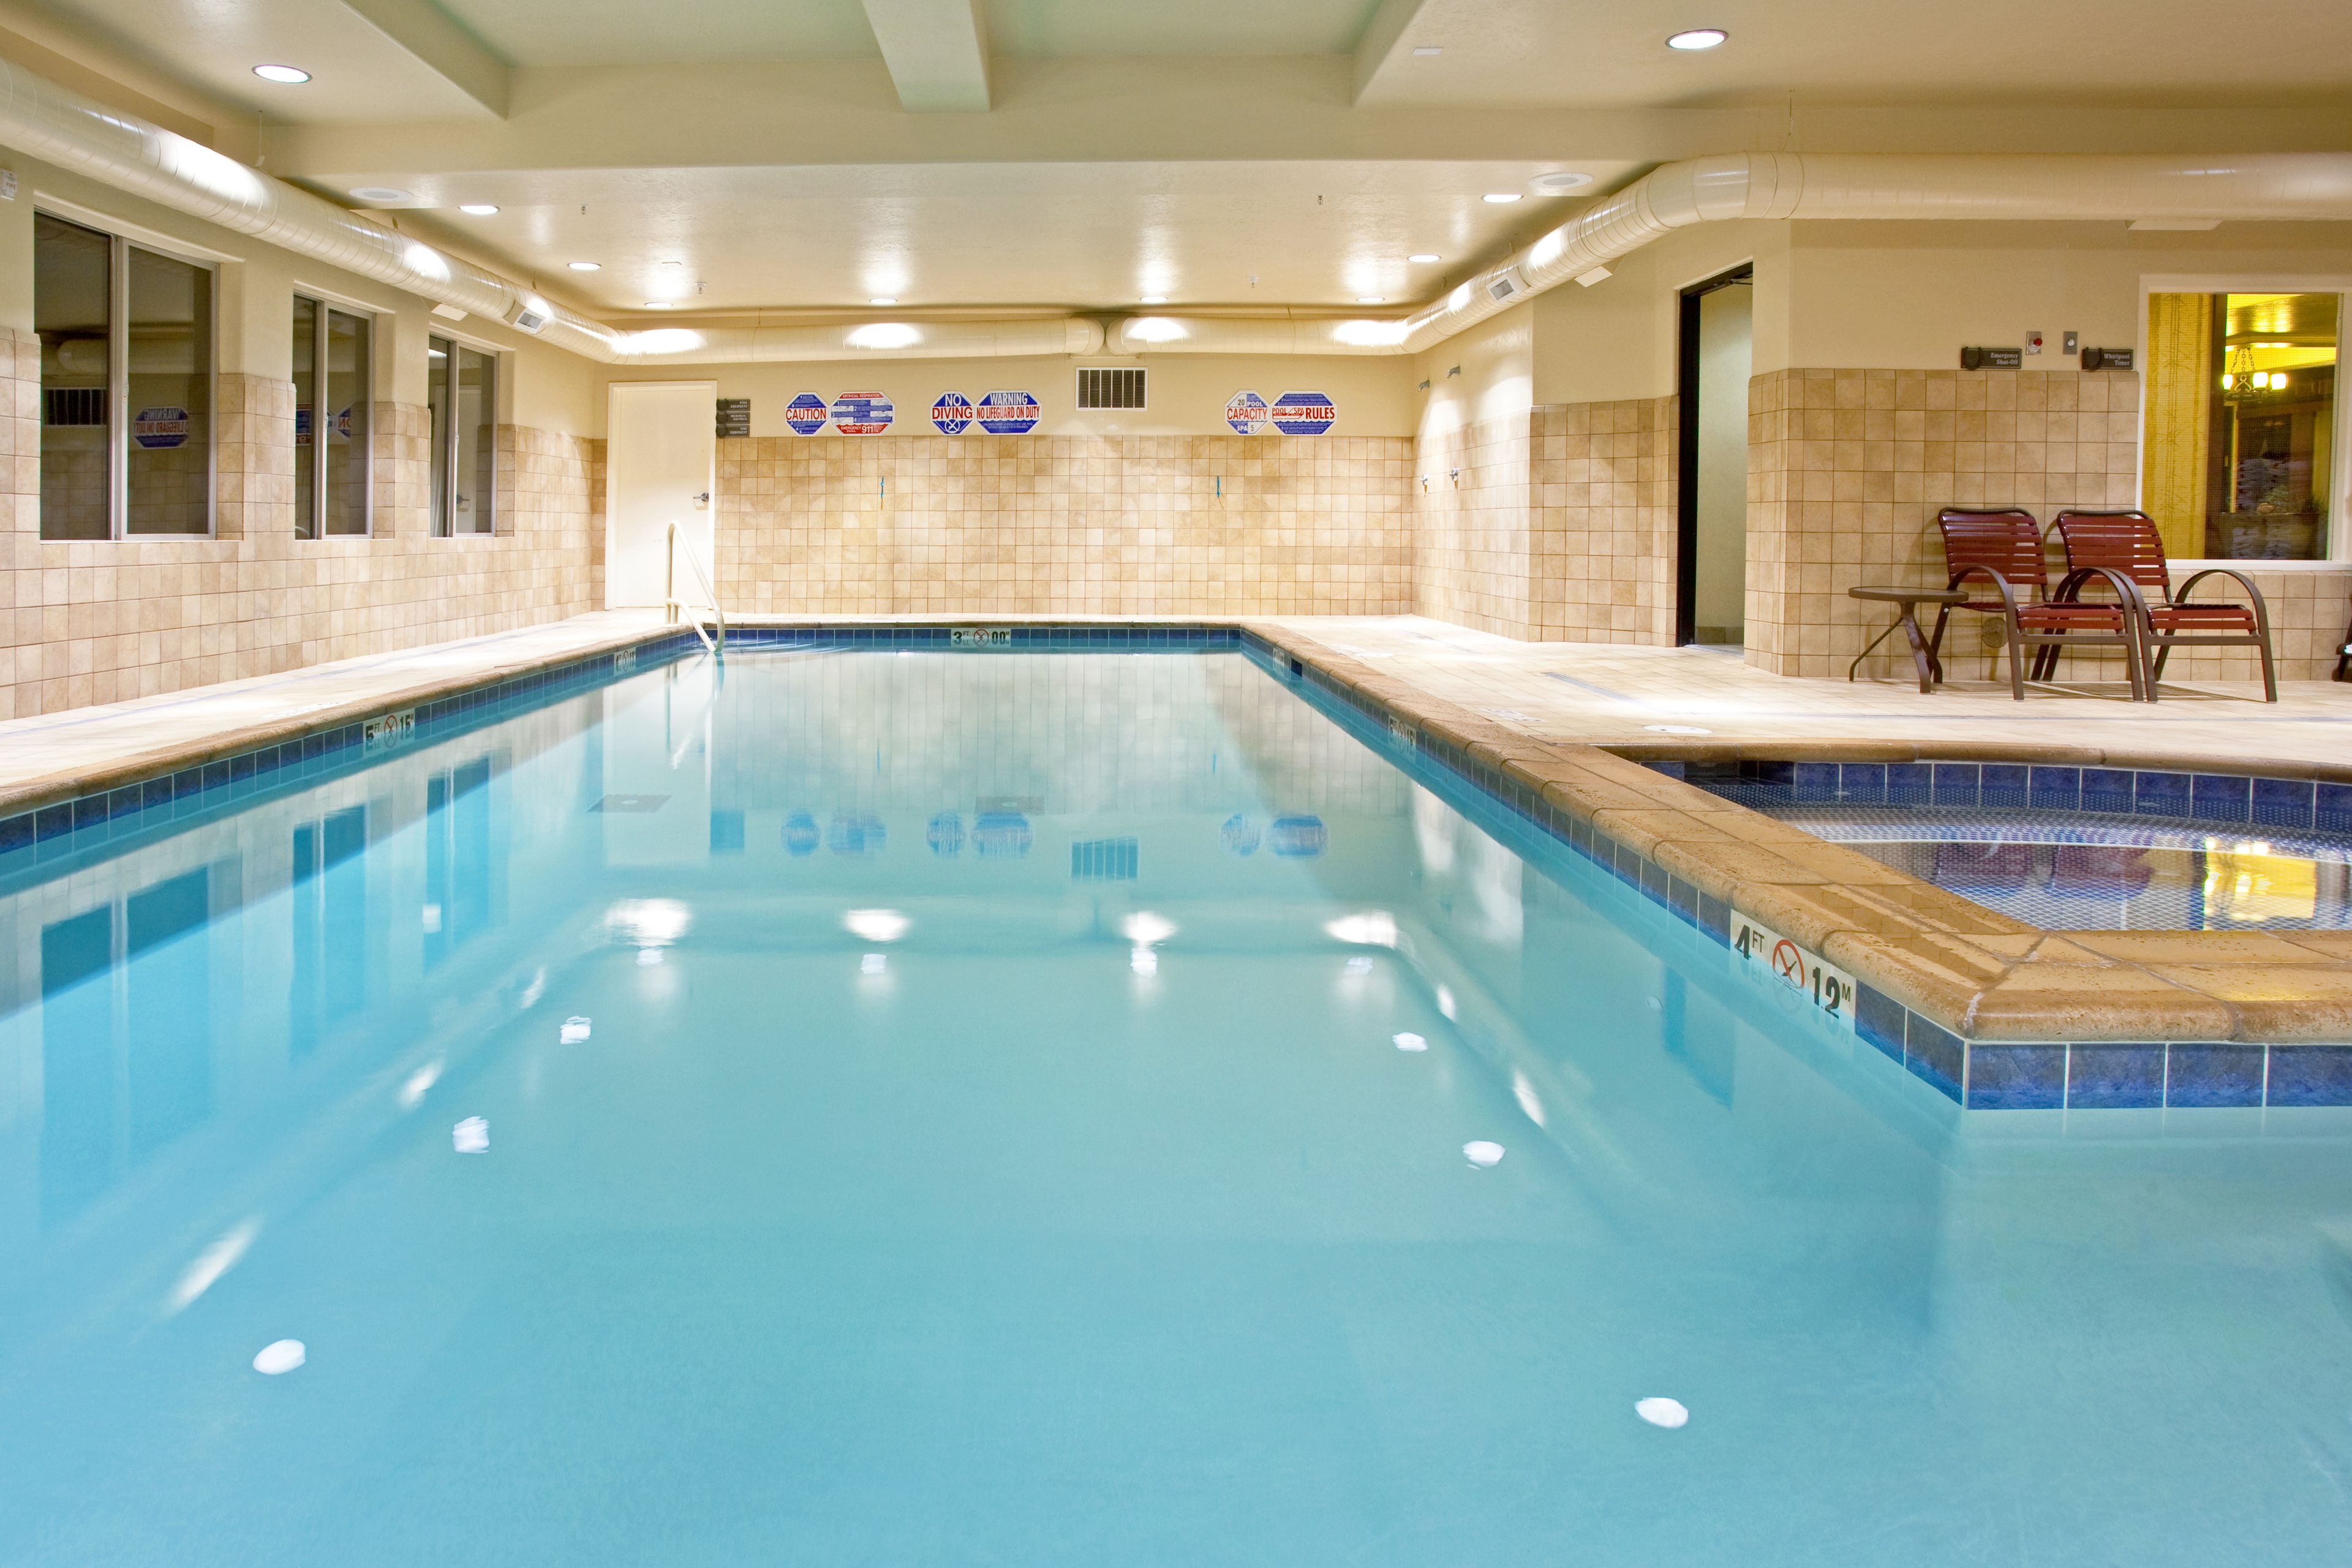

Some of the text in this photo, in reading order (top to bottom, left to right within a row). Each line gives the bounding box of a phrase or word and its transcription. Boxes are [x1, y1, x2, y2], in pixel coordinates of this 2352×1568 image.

[945, 394, 962, 407] NO
[990, 393, 1028, 405] WARNING
[786, 409, 826, 420] CAUTION
[932, 407, 973, 420] DIVING
[977, 405, 1040, 419] NO LIFEGUARD ON DUTY
[1227, 408, 1267, 420] CAPACITY
[1305, 407, 1335, 419] RULES
[366, 725, 374, 741] 5
